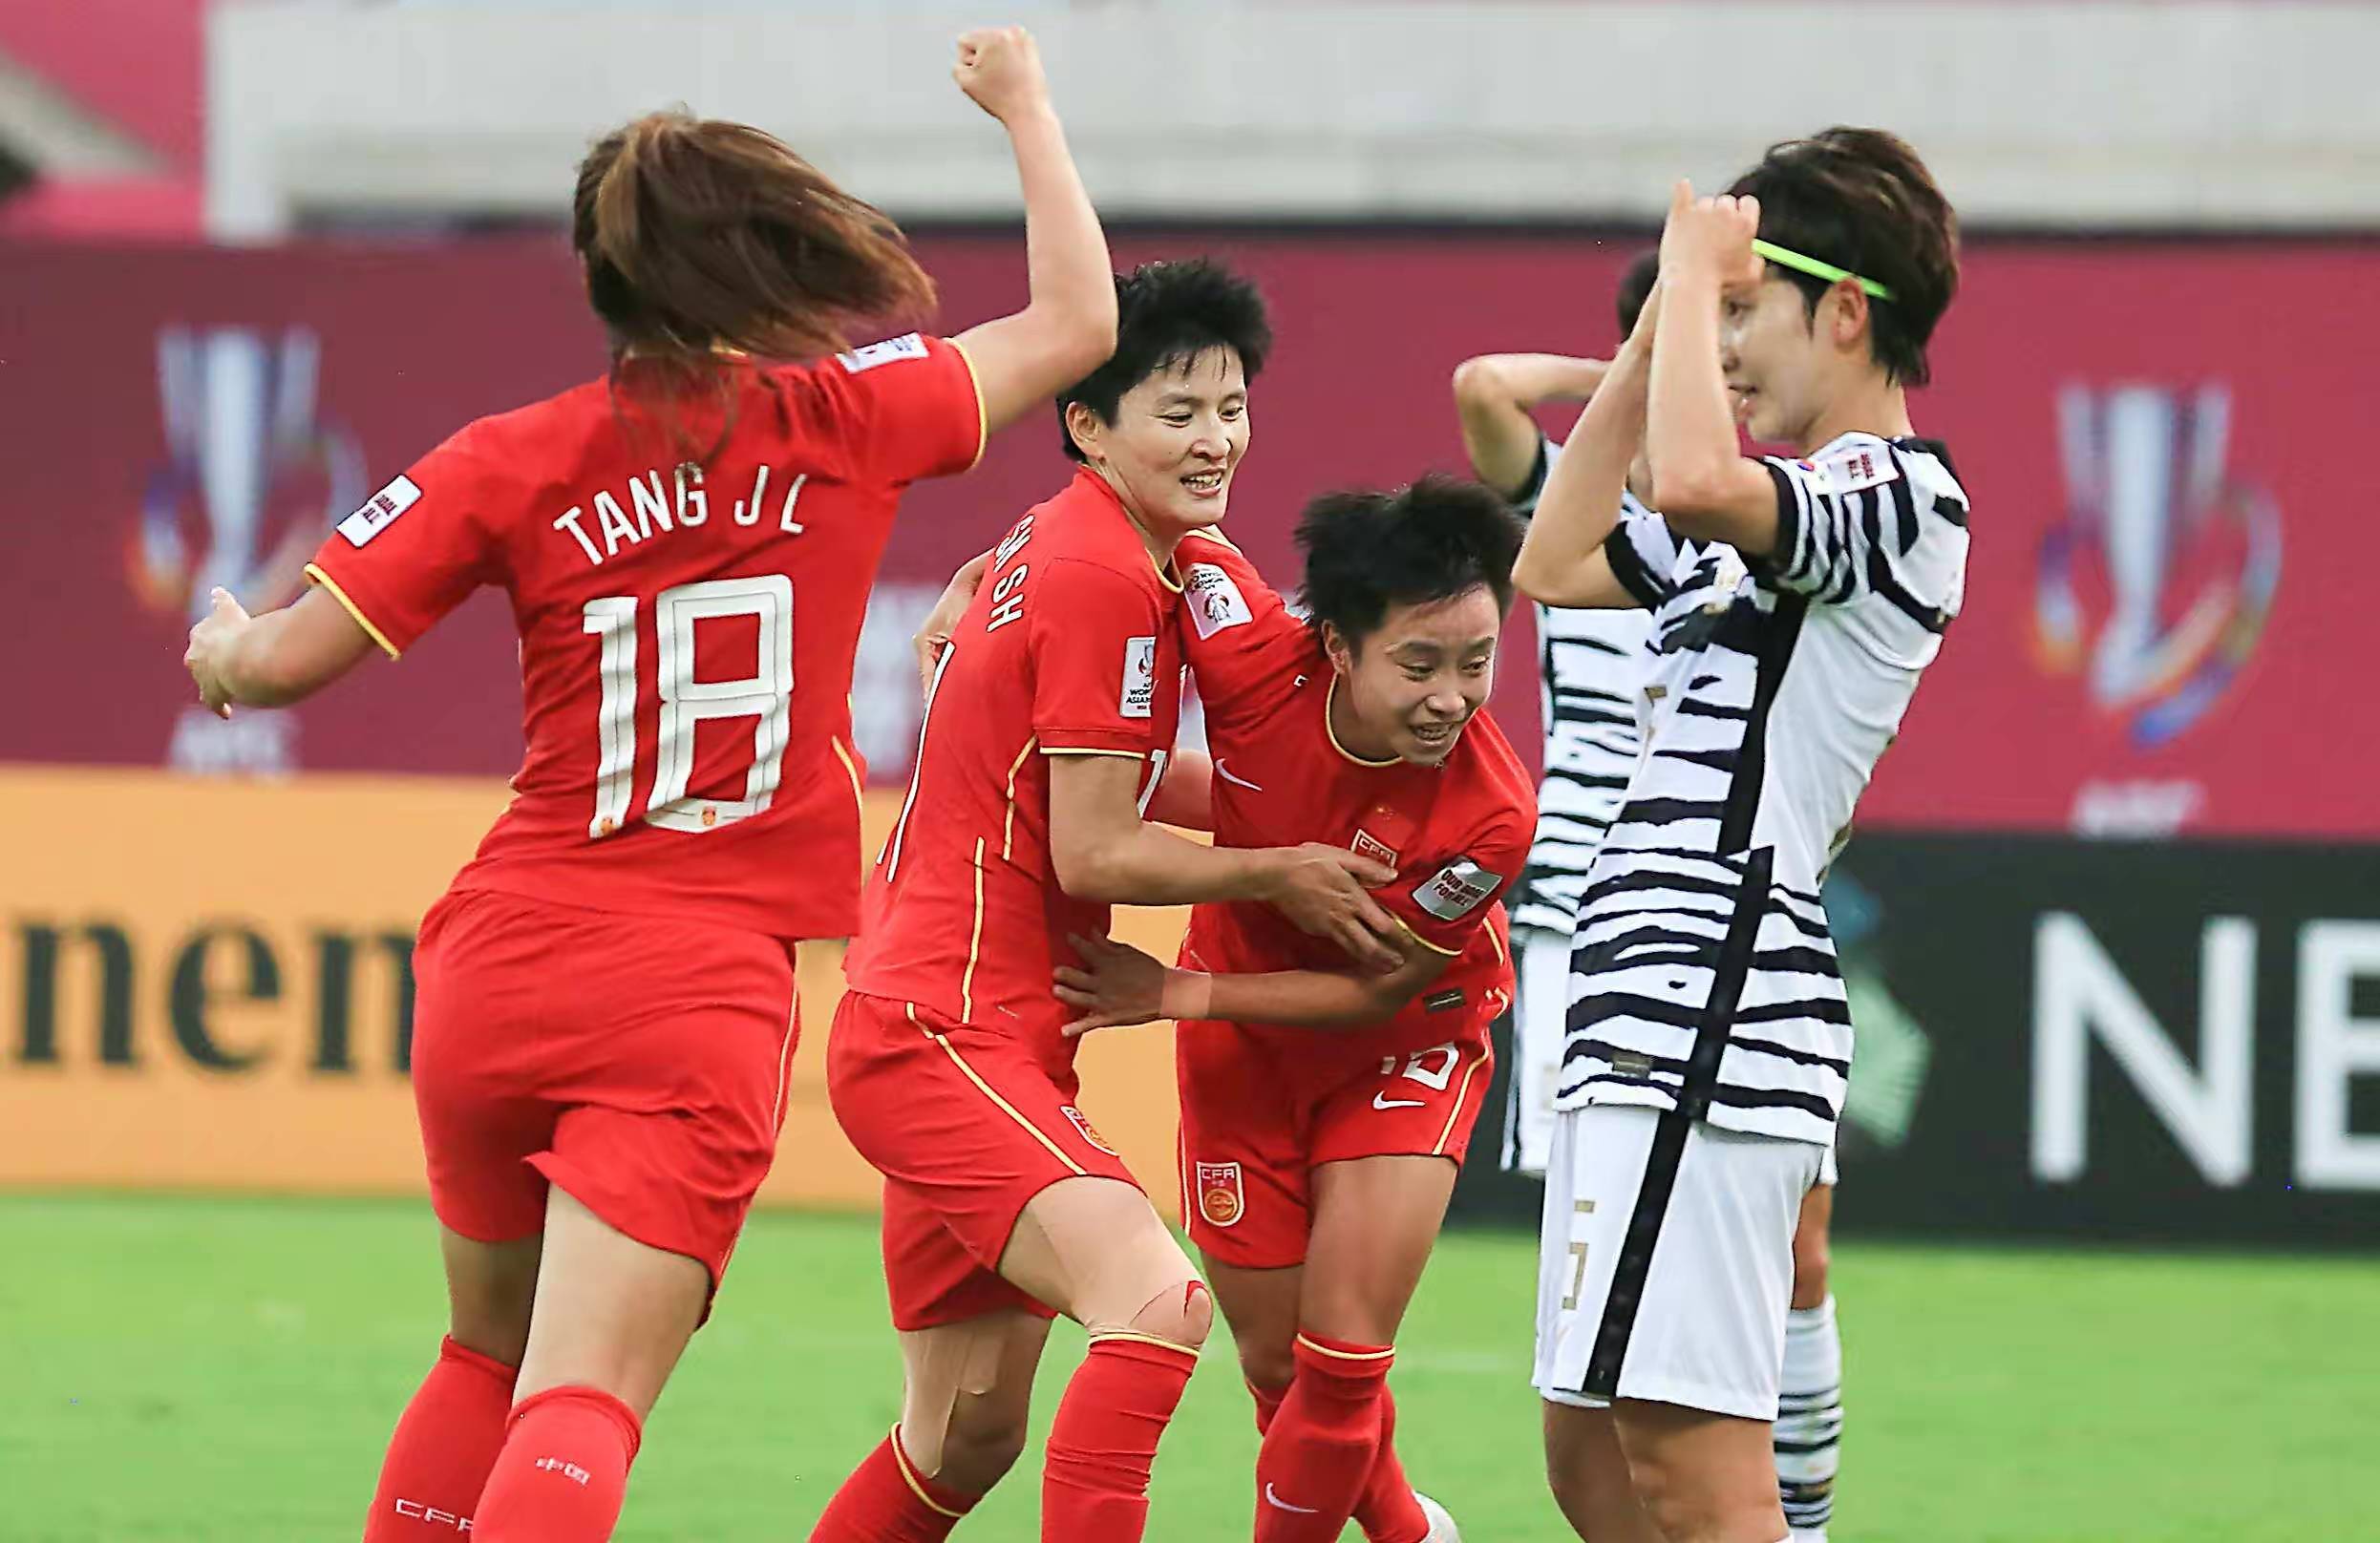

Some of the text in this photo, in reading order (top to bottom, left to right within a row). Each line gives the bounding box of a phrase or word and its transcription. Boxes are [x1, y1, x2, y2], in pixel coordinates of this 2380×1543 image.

[553, 462, 709, 565] TANG
[582, 574, 795, 839] 18
[2030, 910, 2380, 1191] NE
[1201, 1167, 1237, 1180] CFA
